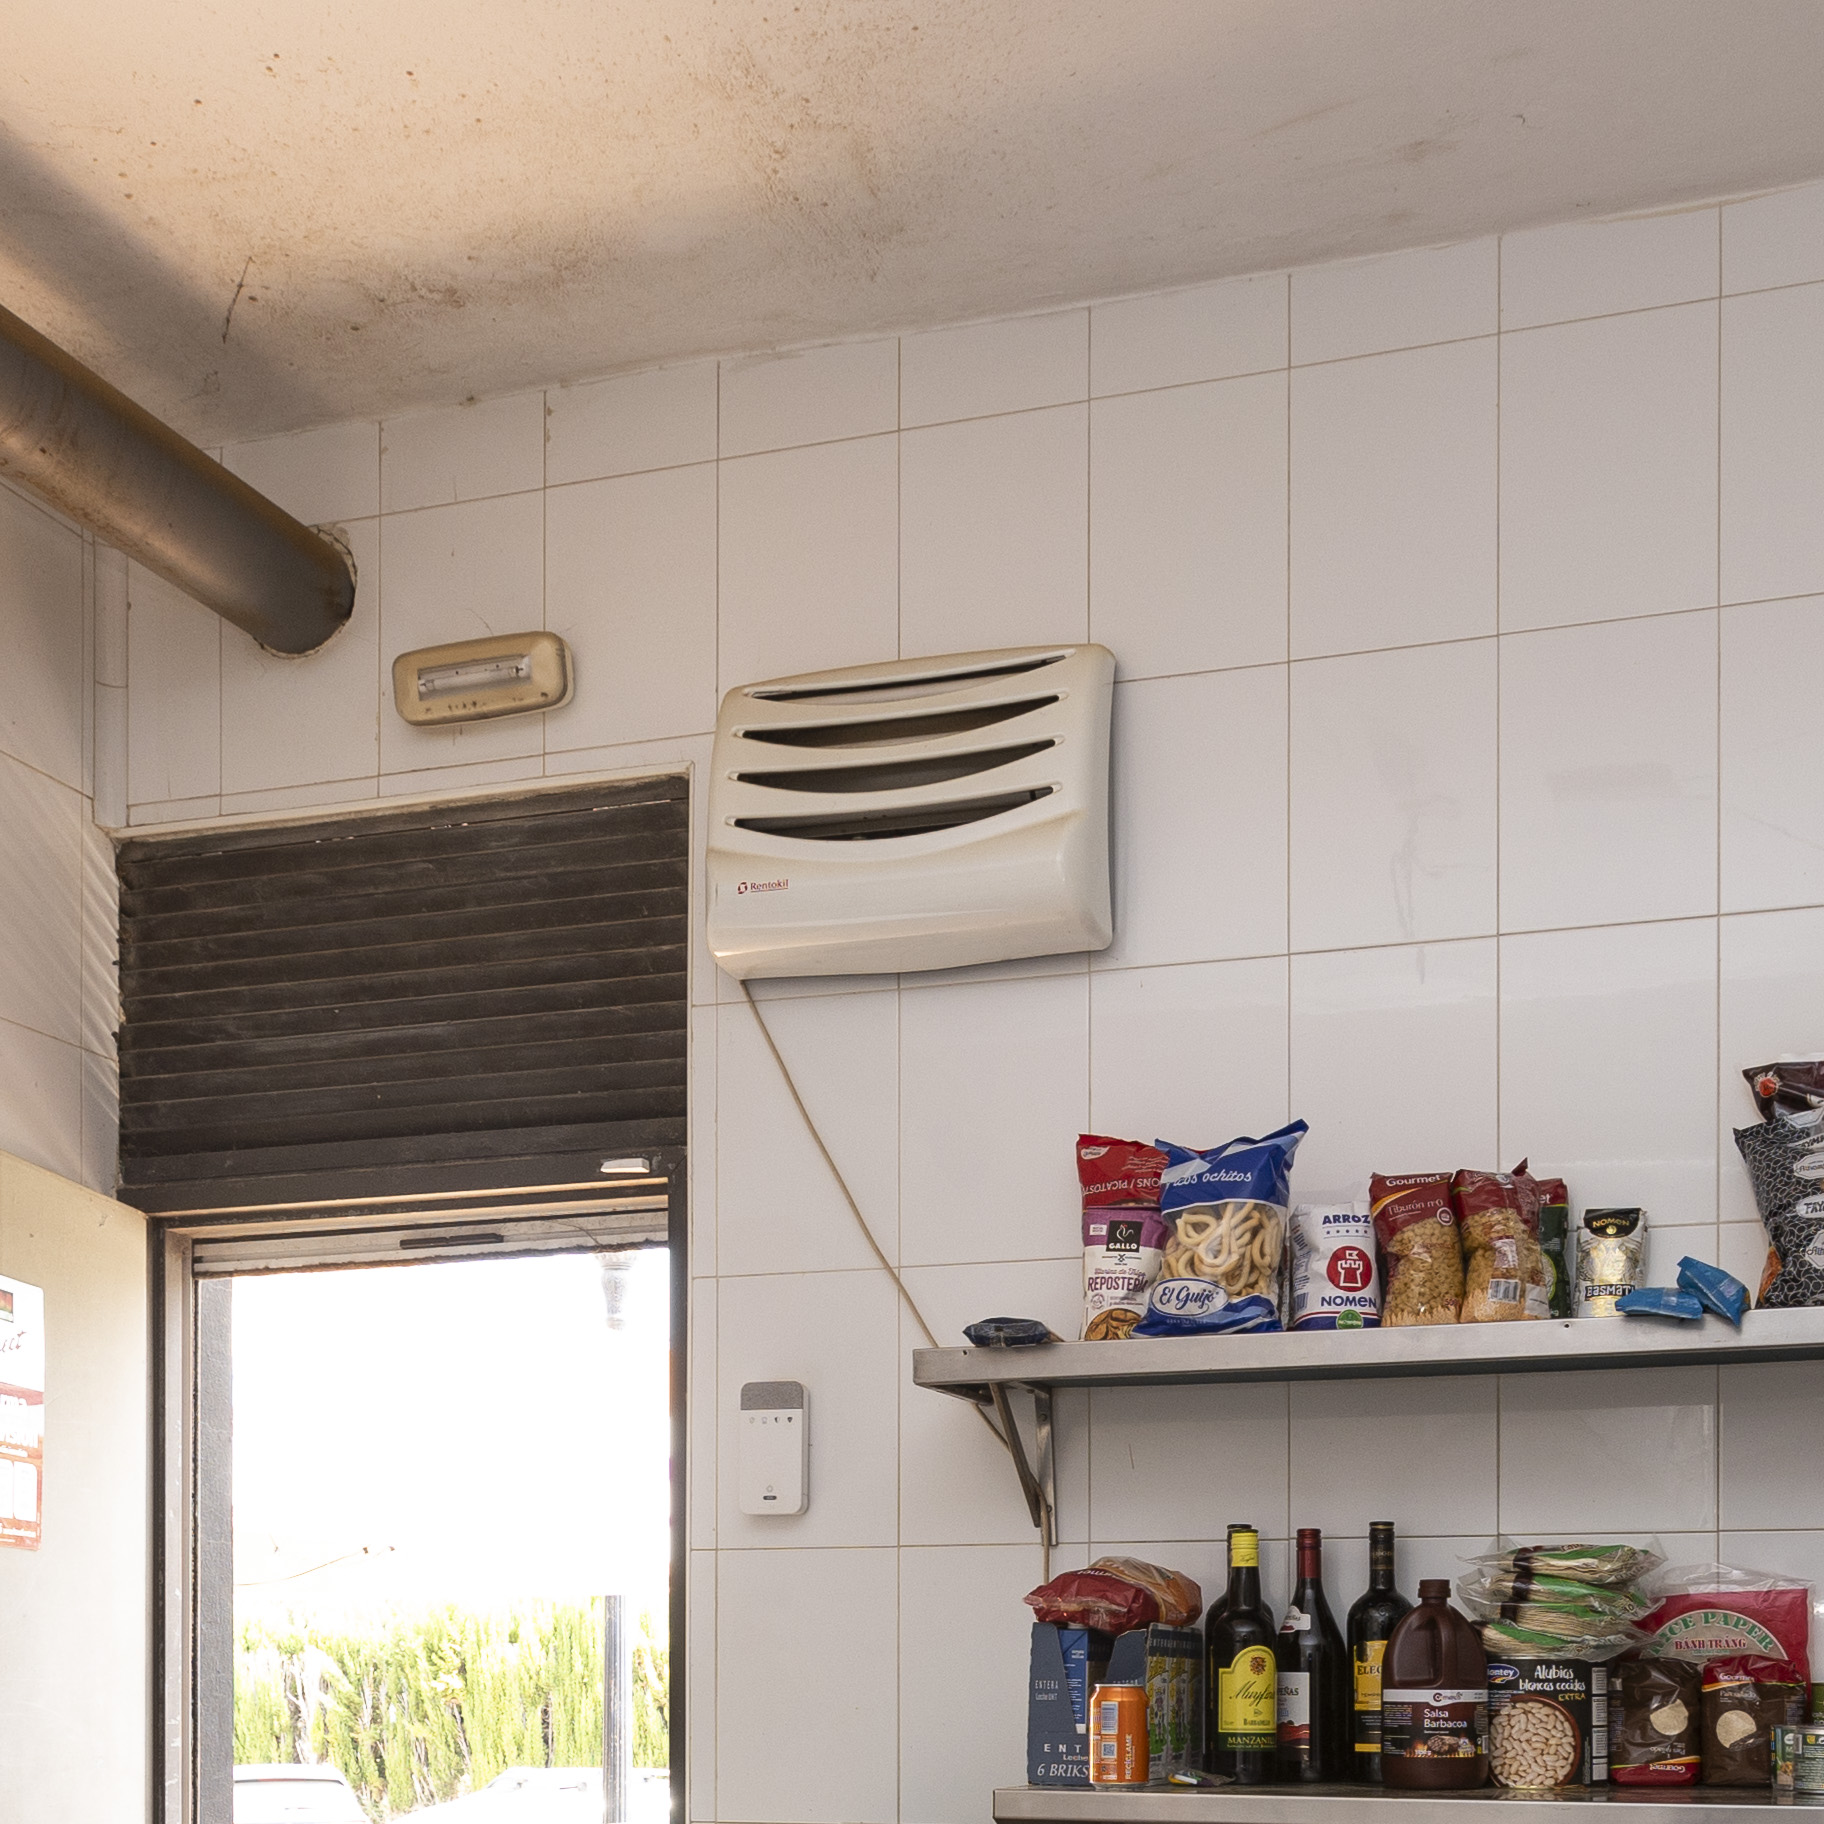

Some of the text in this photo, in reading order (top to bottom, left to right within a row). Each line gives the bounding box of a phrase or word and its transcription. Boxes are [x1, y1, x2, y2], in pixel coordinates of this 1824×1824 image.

[750, 879, 789, 890] Rentokil
[1202, 1169, 1253, 1183] ochitos
[1385, 1174, 1441, 1188] Gourmet
[1387, 1199, 1425, 1217] Tiburón
[1322, 1213, 1372, 1226] ARROZ
[1108, 1241, 1138, 1251] GALLO
[1159, 1286, 1172, 1306] El
[1584, 1284, 1636, 1298] BASMATI
[1320, 1295, 1376, 1308] NOMEN
[1702, 1611, 1775, 1653] PAPER
[1675, 1636, 1706, 1650] BÁNH
[1534, 1664, 1574, 1681] Alubias
[1719, 1672, 1755, 1683] Gourmet
[1034, 1679, 1059, 1690] ENTERA
[1519, 1678, 1586, 1692] blancas cocidas
[1558, 1692, 1586, 1702] EXTRA
[1423, 1708, 1449, 1719] Salsa
[1423, 1718, 1468, 1729] Barbacoa
[1063, 1754, 1089, 1762] Leche
[1037, 1763, 1090, 1778] 6 BRIKS
